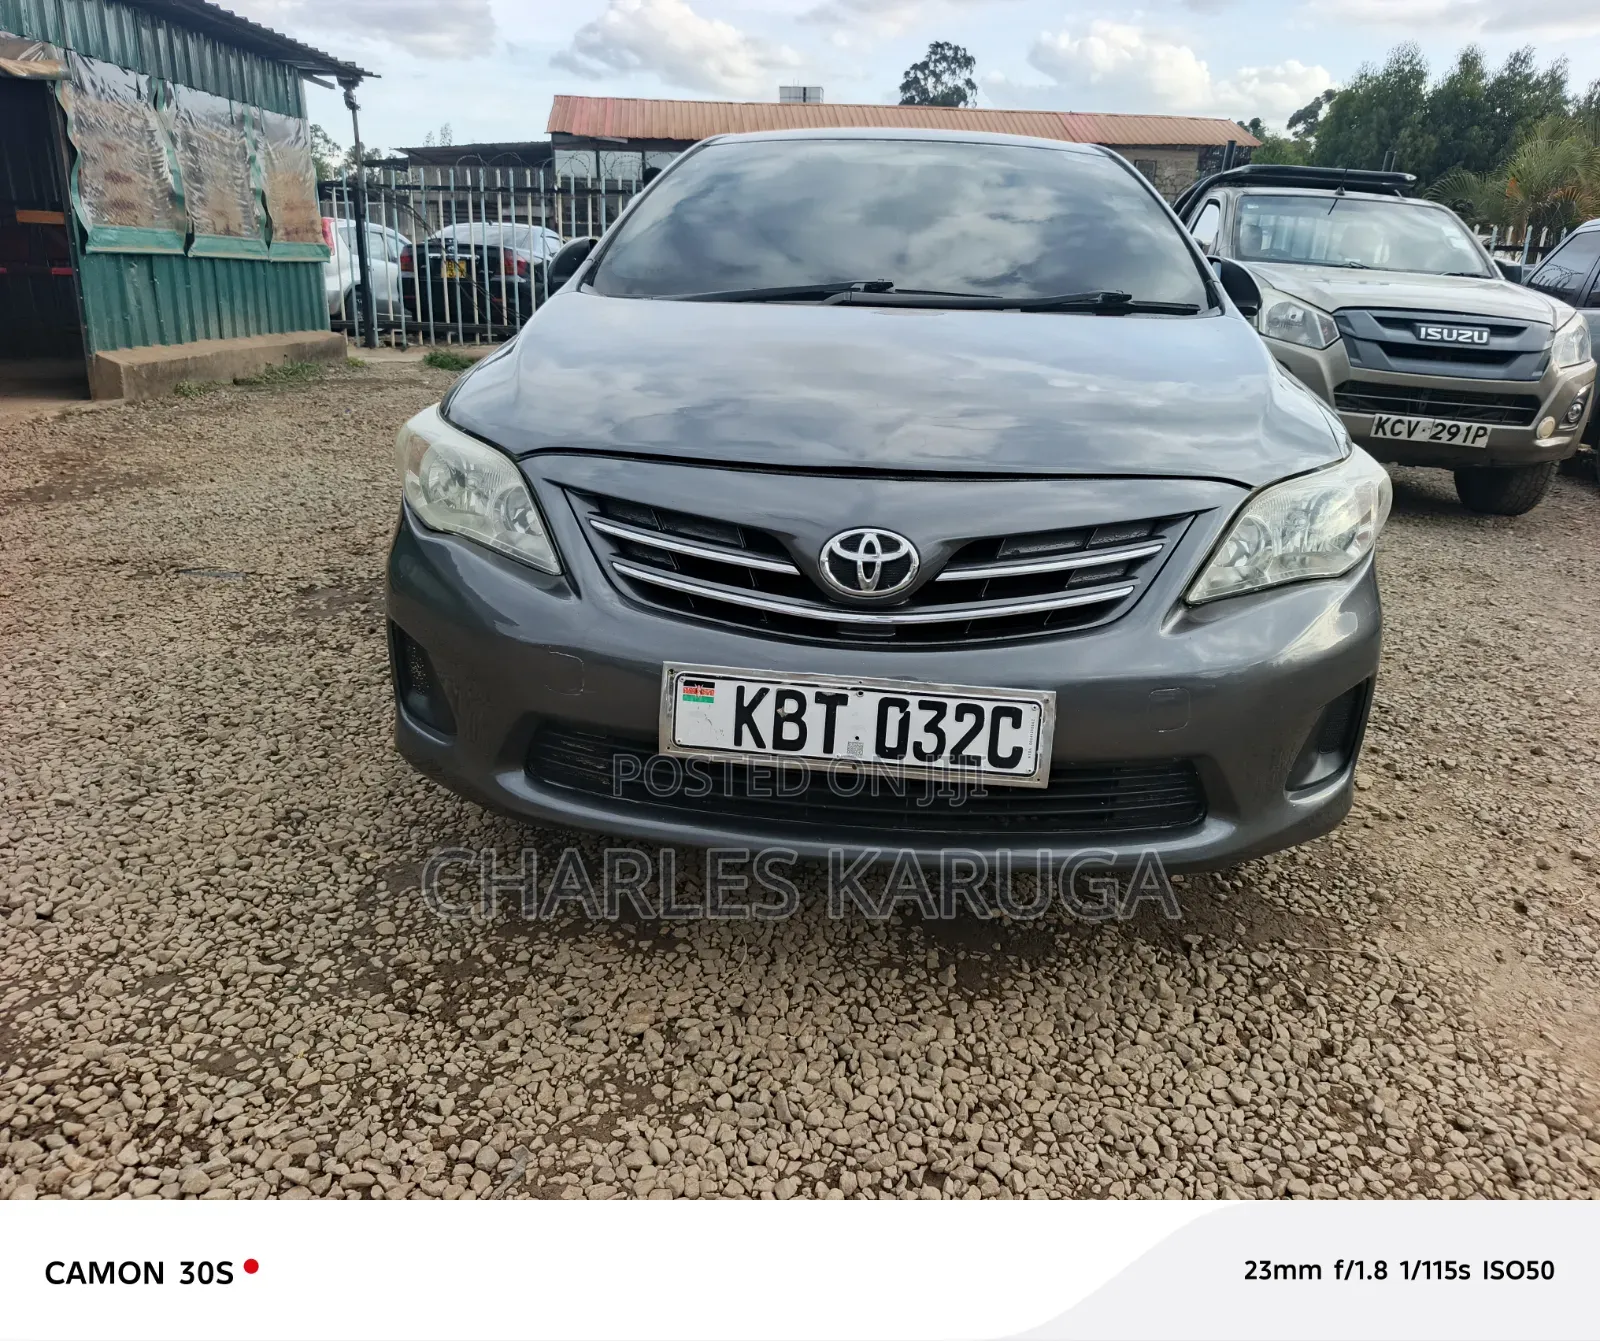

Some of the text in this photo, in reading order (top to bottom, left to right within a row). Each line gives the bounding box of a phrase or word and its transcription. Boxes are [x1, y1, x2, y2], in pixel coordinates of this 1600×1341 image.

[1419, 326, 1488, 344] ISUZU
[1373, 416, 1488, 444] KCV 291P
[733, 685, 849, 755] KBT
[875, 696, 1023, 769] 032C
